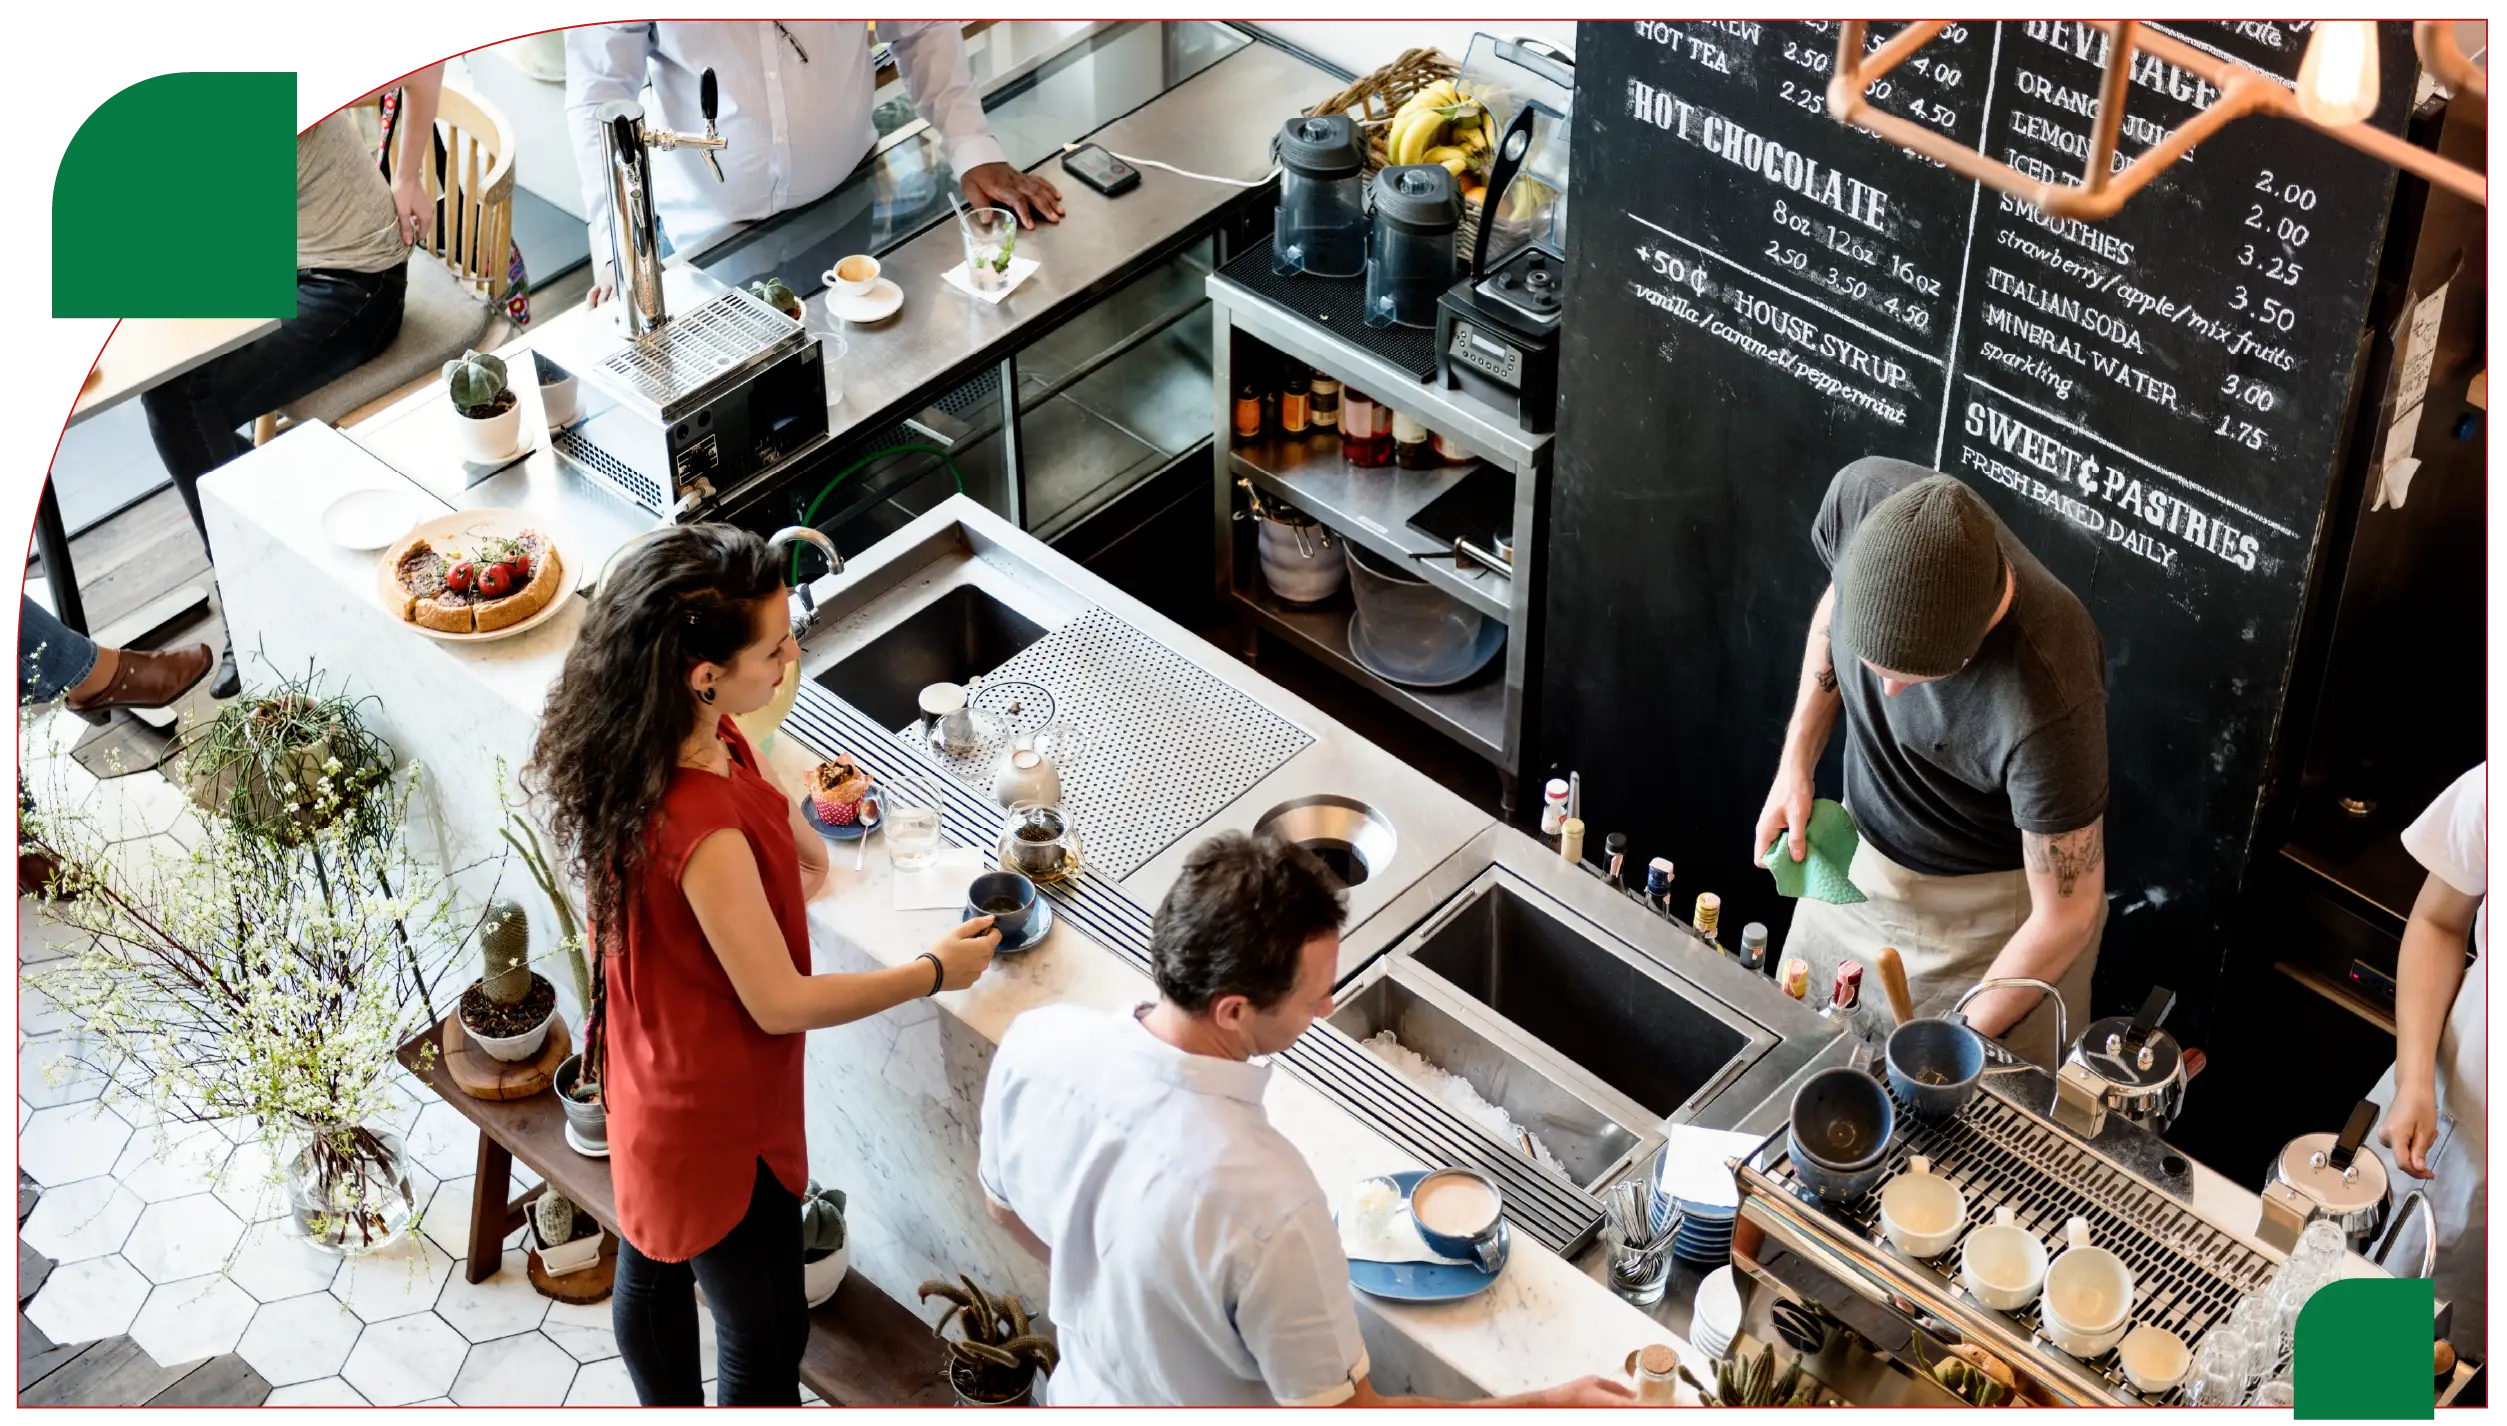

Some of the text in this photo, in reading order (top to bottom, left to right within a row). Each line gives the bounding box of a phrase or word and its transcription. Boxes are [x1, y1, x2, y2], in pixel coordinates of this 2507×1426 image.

[1638, 20, 1825, 113] HOT TEA 2.25
[1783, 42, 1828, 71] 2.50
[1909, 98, 1956, 127] 4.50
[1913, 58, 1962, 86] 4.00
[1634, 81, 1888, 232] HOT CHOCOLATE
[2018, 71, 2101, 119] ORANG
[2255, 169, 2316, 211] 2.00
[2000, 191, 2295, 332] SMOOTHIES 3.50
[2006, 149, 2055, 186] ICED
[2237, 244, 2304, 286] 3.25
[2245, 204, 2310, 247] 2.00
[1734, 289, 1818, 351] HOUSE
[1819, 333, 1906, 390] SYRUP
[1826, 267, 1867, 299] 3.50
[1884, 298, 1929, 328] 4.50
[1988, 266, 2274, 411] ITALIAN SODA 3.00
[1980, 341, 2073, 401] sparkling
[1986, 304, 2268, 450] MINERAL WATER 1.75
[2227, 330, 2295, 371] fruits
[1961, 445, 2179, 568] FRESH BAKED DAILY
